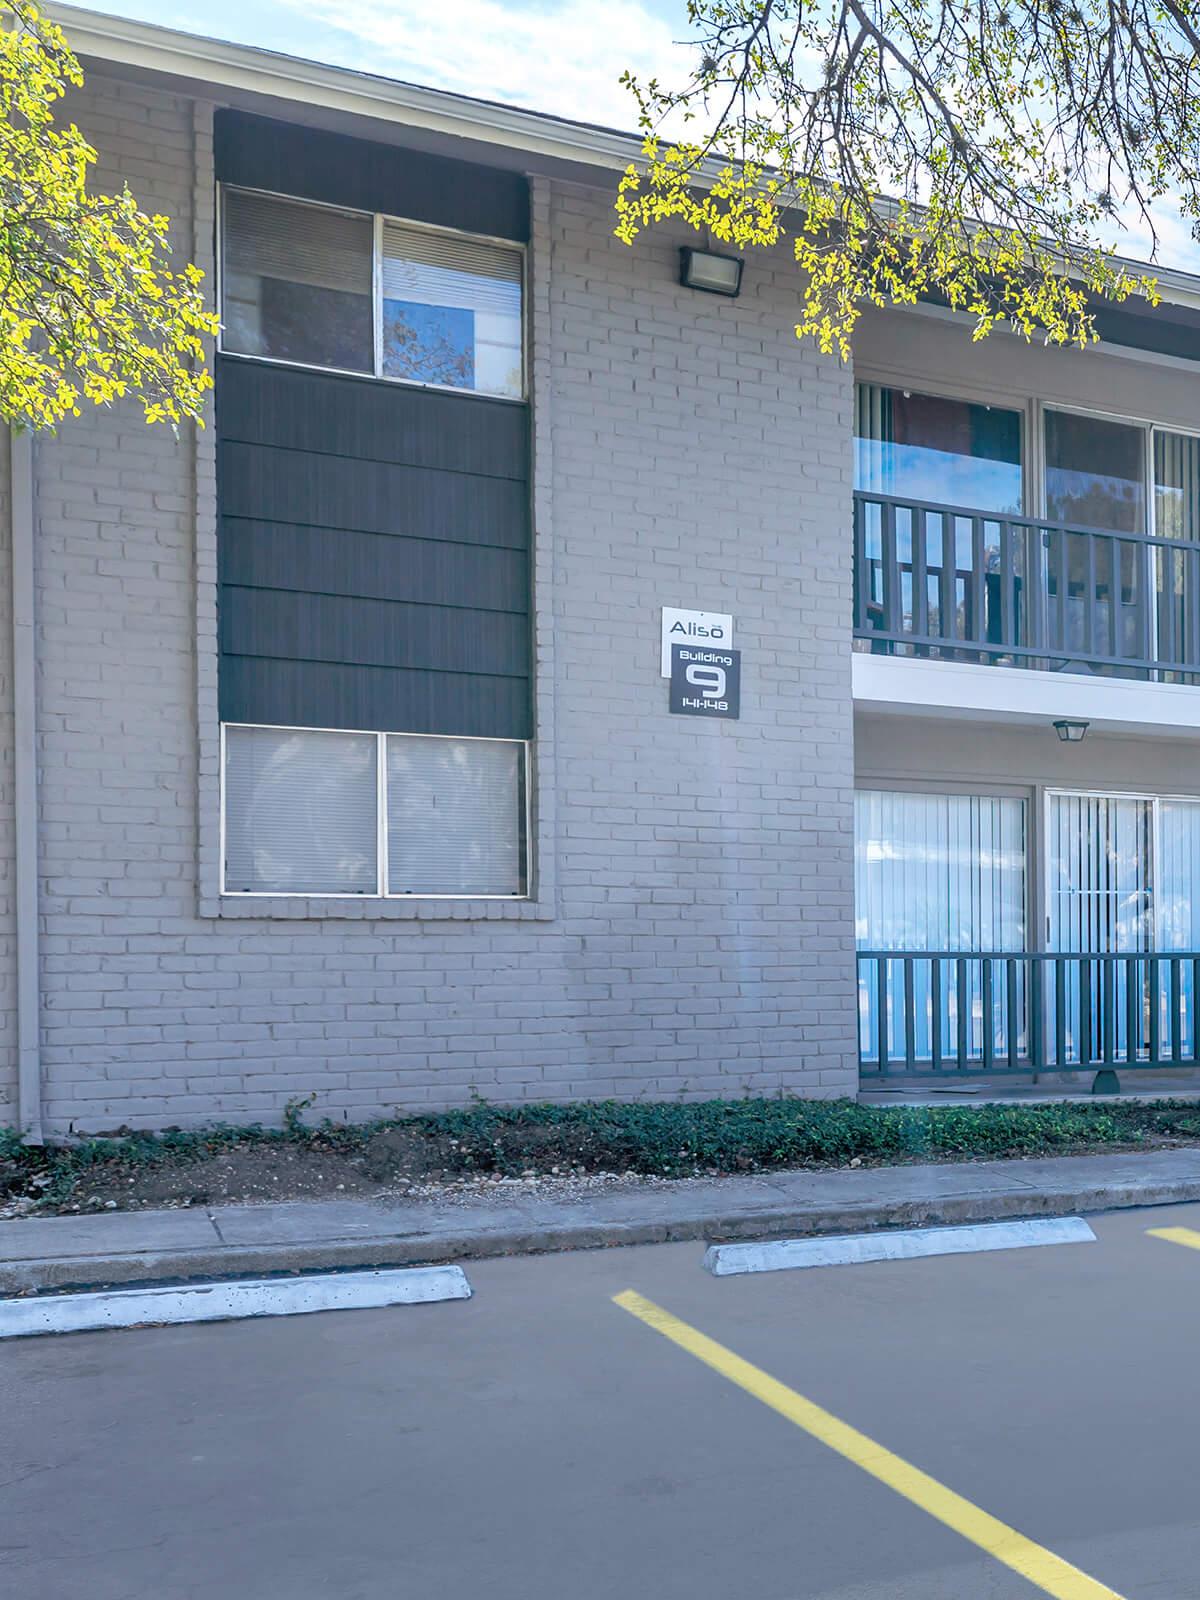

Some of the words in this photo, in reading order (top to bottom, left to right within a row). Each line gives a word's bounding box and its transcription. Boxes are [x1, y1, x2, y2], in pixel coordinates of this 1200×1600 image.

[679, 650, 733, 666] Building
[686, 663, 726, 699] 9
[682, 697, 729, 711] 141-148
